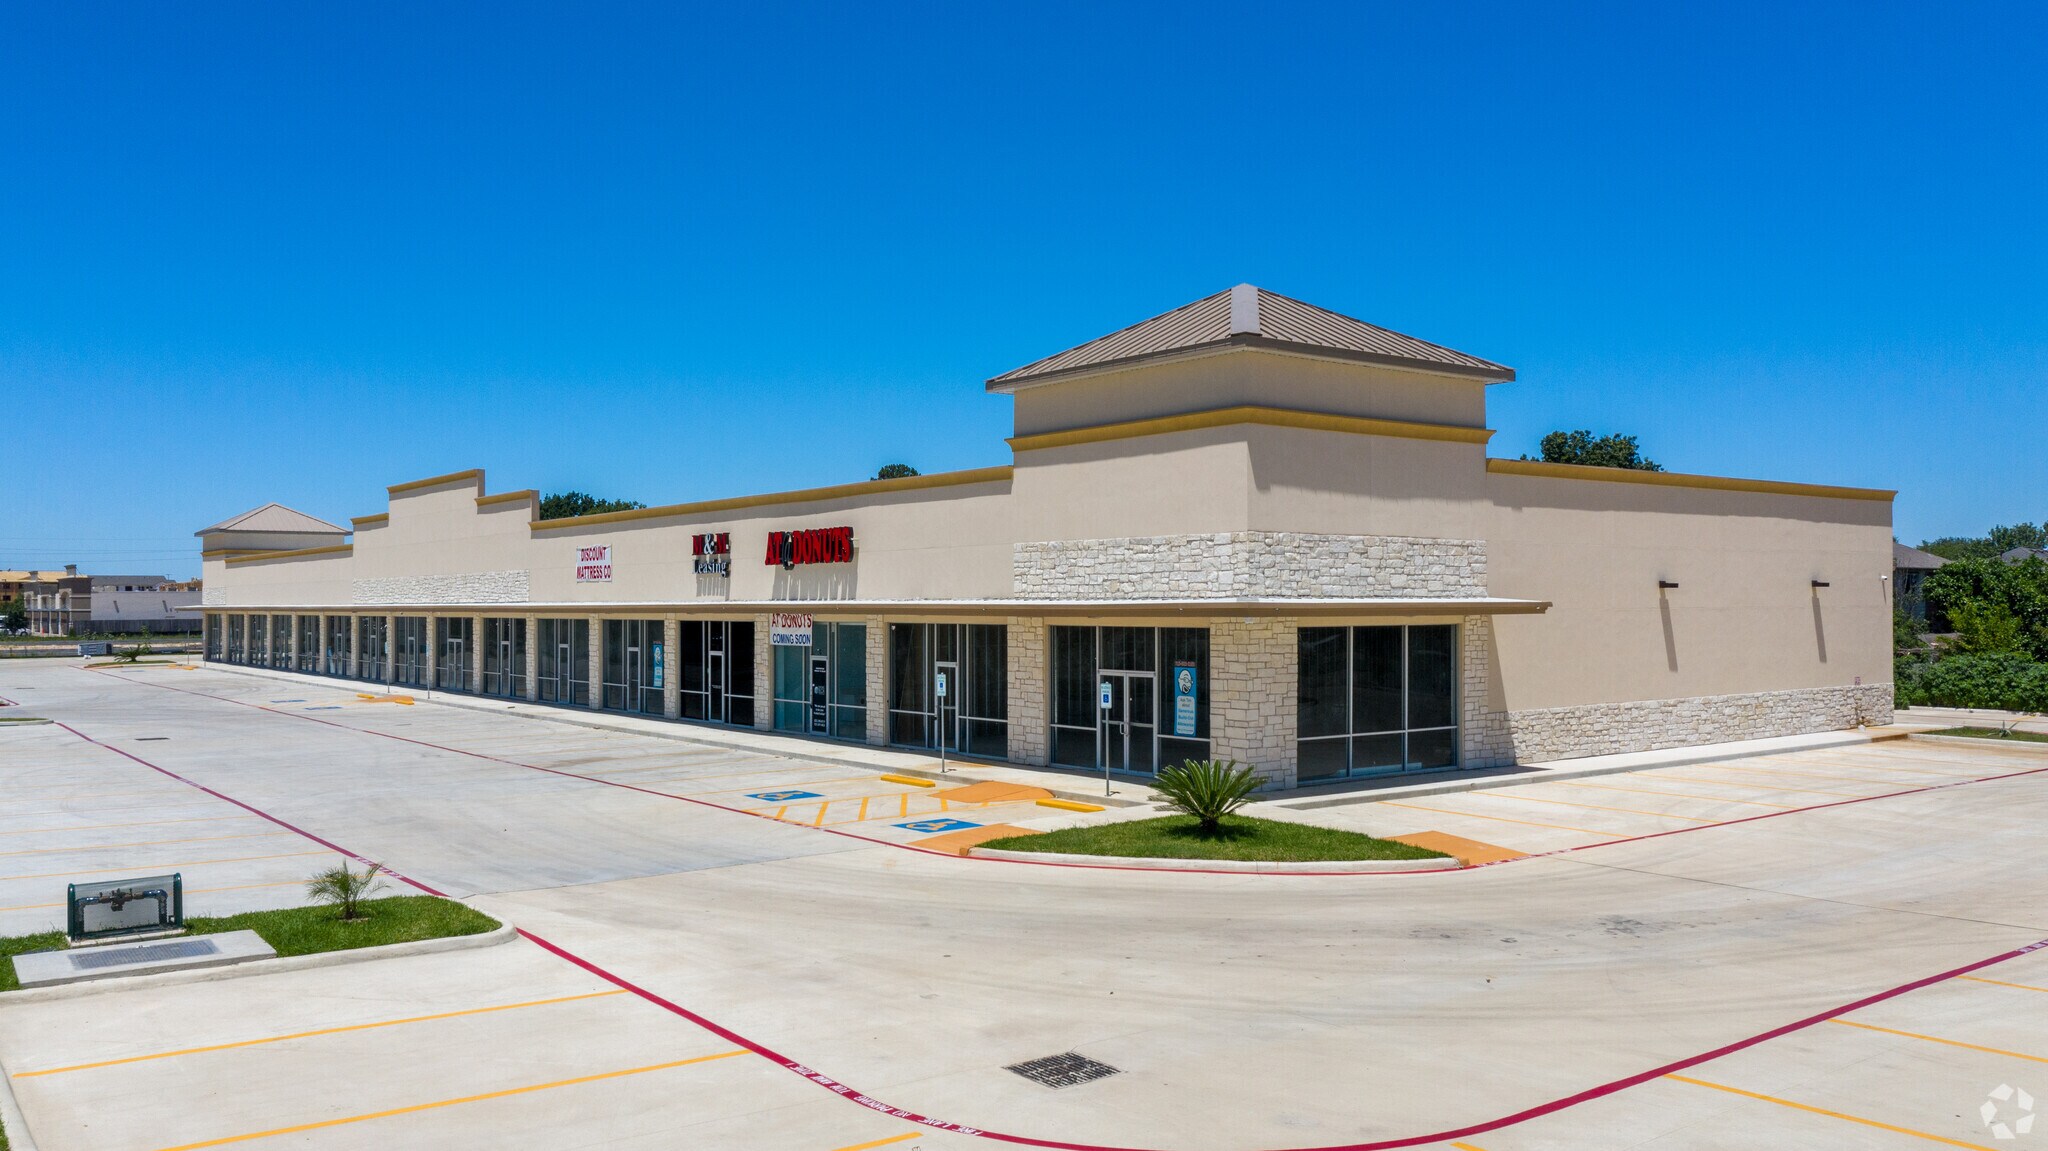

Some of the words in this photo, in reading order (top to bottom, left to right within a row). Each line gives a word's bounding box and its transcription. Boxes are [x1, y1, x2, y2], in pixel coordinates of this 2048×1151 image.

[581, 546, 606, 561] DISCOUNT
[576, 565, 603, 579] MATTRESS
[604, 564, 612, 578] CO
[692, 559, 727, 577] Leasing
[771, 613, 781, 628] AT
[781, 613, 812, 628] DONUTS
[772, 633, 795, 644] COMING
[795, 634, 811, 645] SOON
